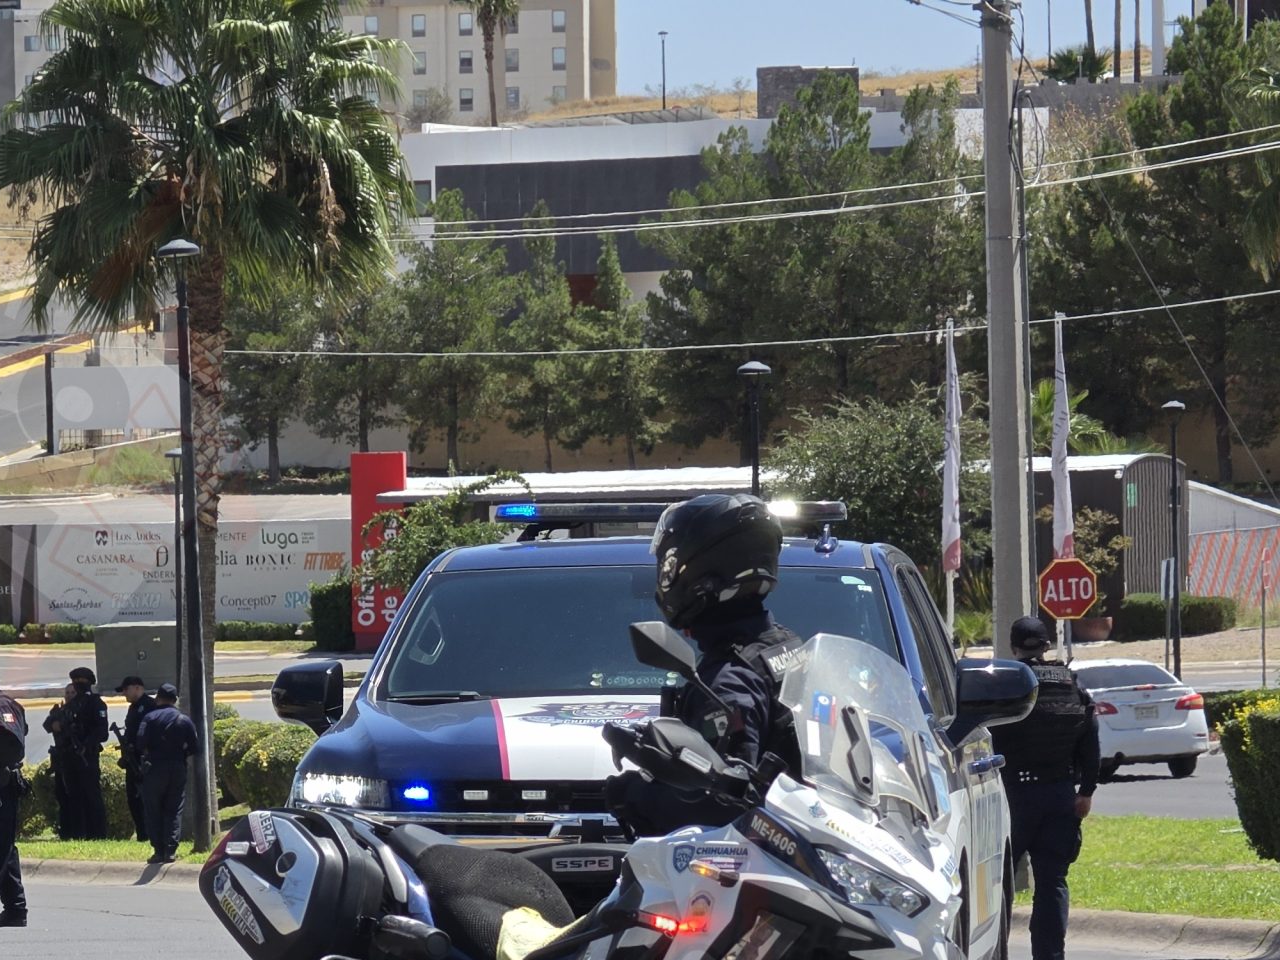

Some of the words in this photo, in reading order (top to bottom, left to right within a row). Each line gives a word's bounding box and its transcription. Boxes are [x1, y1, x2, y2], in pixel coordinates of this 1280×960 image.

[261, 527, 299, 549] luga
[76, 554, 135, 565] CASANARA
[1043, 577, 1093, 602] ALTO
[220, 594, 277, 609] Concept07
[381, 595, 398, 623] de
[750, 815, 797, 856] ME-1406
[696, 848, 748, 856] CHIHUAHUA
[555, 859, 610, 868] SSPE
